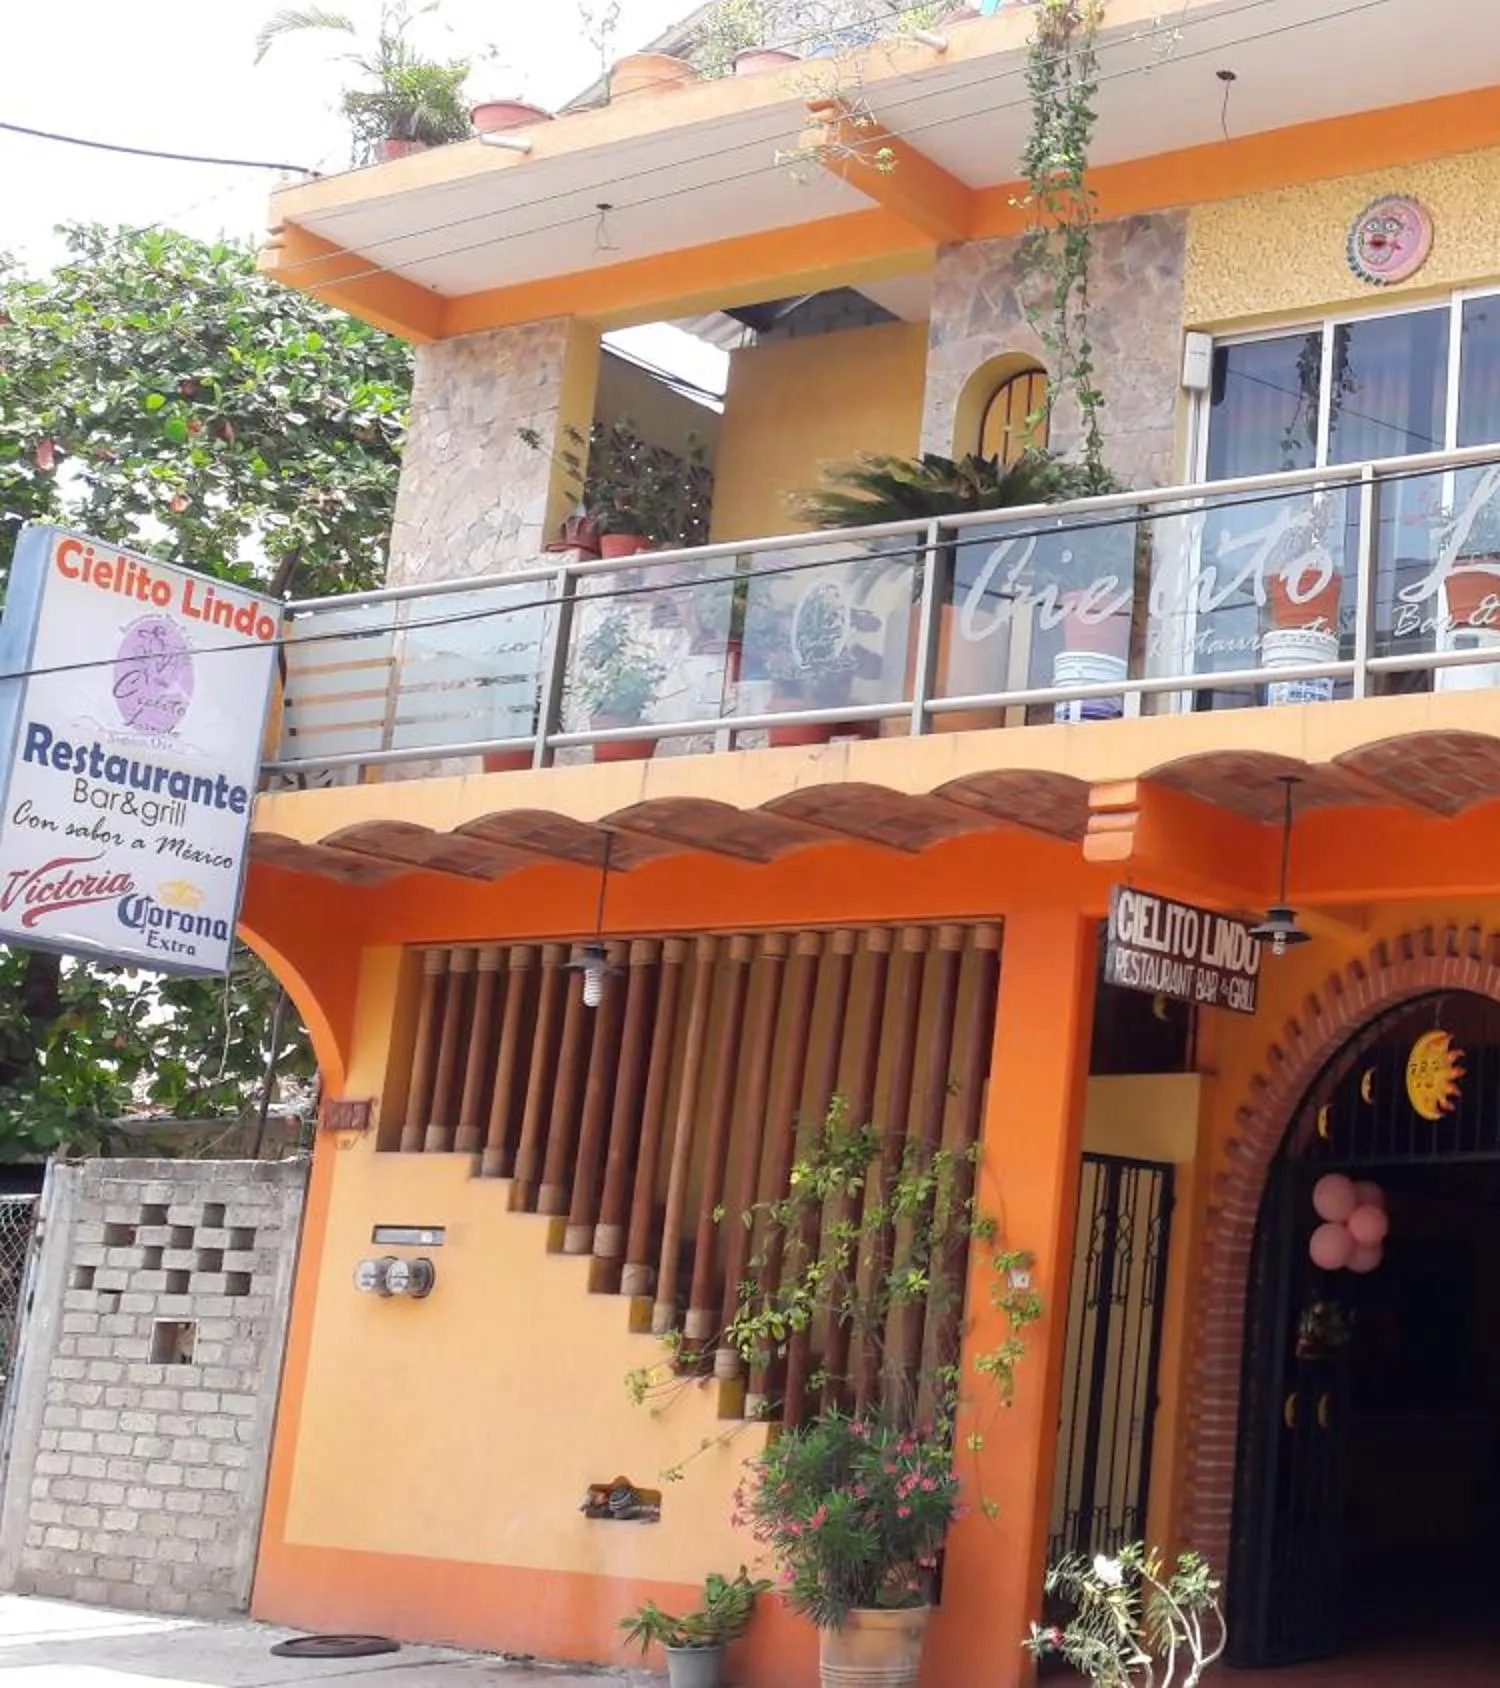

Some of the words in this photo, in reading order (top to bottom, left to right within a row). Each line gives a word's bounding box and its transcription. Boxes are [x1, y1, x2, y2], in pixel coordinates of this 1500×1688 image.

[56, 539, 172, 606] Cielito
[183, 580, 276, 641] Lindo
[22, 722, 248, 814] Restaurante
[73, 777, 186, 828] Bar&grill
[13, 800, 59, 832] Con
[65, 817, 123, 848] sabor
[132, 837, 146, 849] a
[157, 835, 234, 870] México
[1, 853, 135, 927] Victoria
[118, 893, 228, 941] Corona
[146, 930, 196, 957] Extra
[1118, 891, 1198, 958] CIELITO
[1202, 915, 1260, 974] LINDO
[1115, 948, 1194, 997] RESTAURANT
[1196, 968, 1218, 1003] BAR
[1229, 977, 1255, 1012] GRILL
